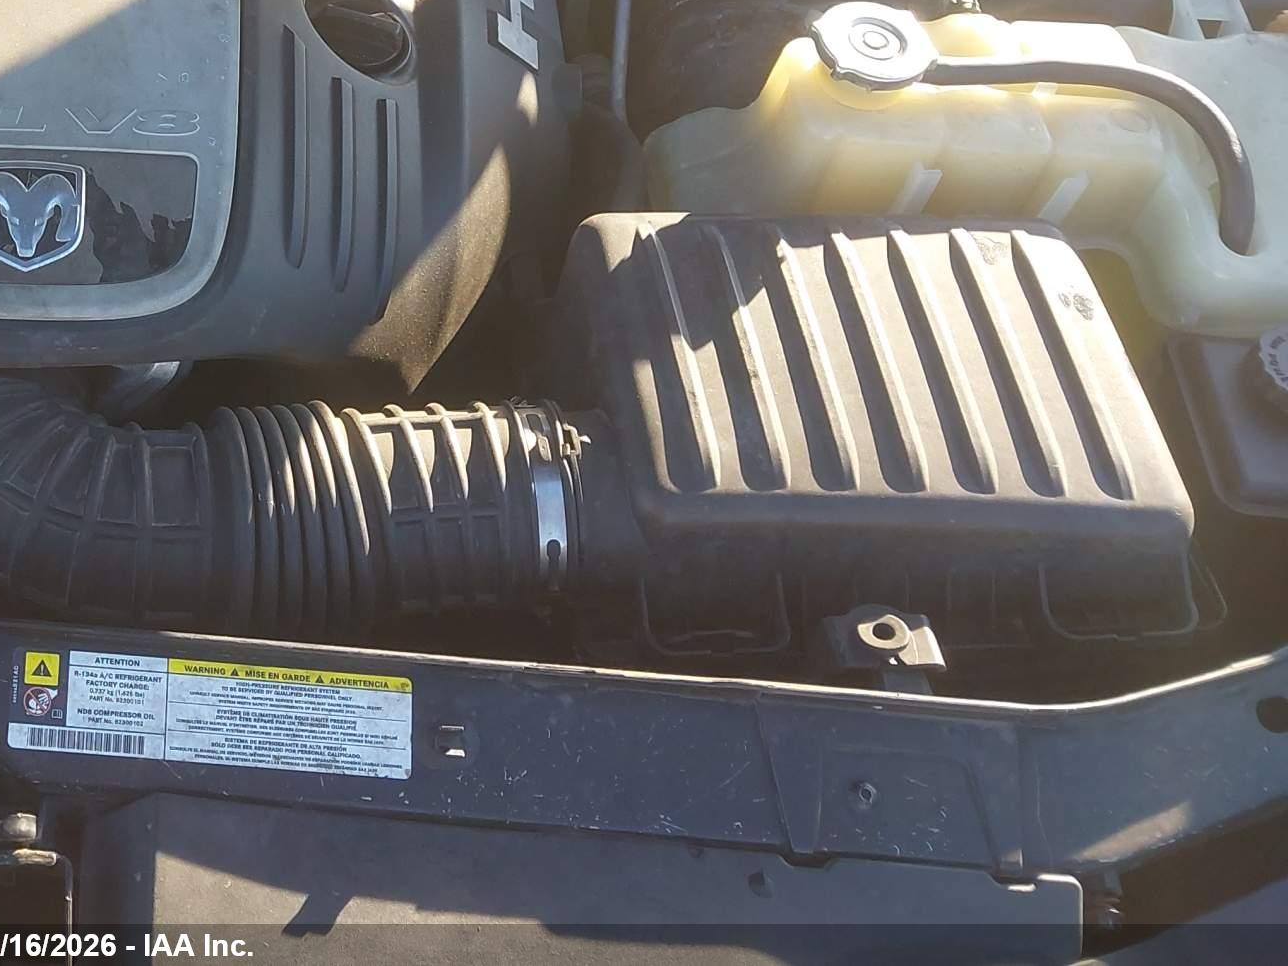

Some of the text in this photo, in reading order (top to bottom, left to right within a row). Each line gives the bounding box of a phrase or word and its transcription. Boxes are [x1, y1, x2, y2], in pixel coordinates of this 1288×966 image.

[65, 106, 201, 136] V8
[94, 657, 141, 667] ATTENTION
[74, 670, 162, 683] R-134a A/C REFRIGERANT
[184, 665, 226, 676] WARNING
[245, 670, 266, 679] MISE
[268, 672, 280, 680] EN
[282, 673, 311, 683] GARDE
[328, 677, 389, 689] ADVERTENCIA
[93, 709, 142, 718] COMPRESSOR
